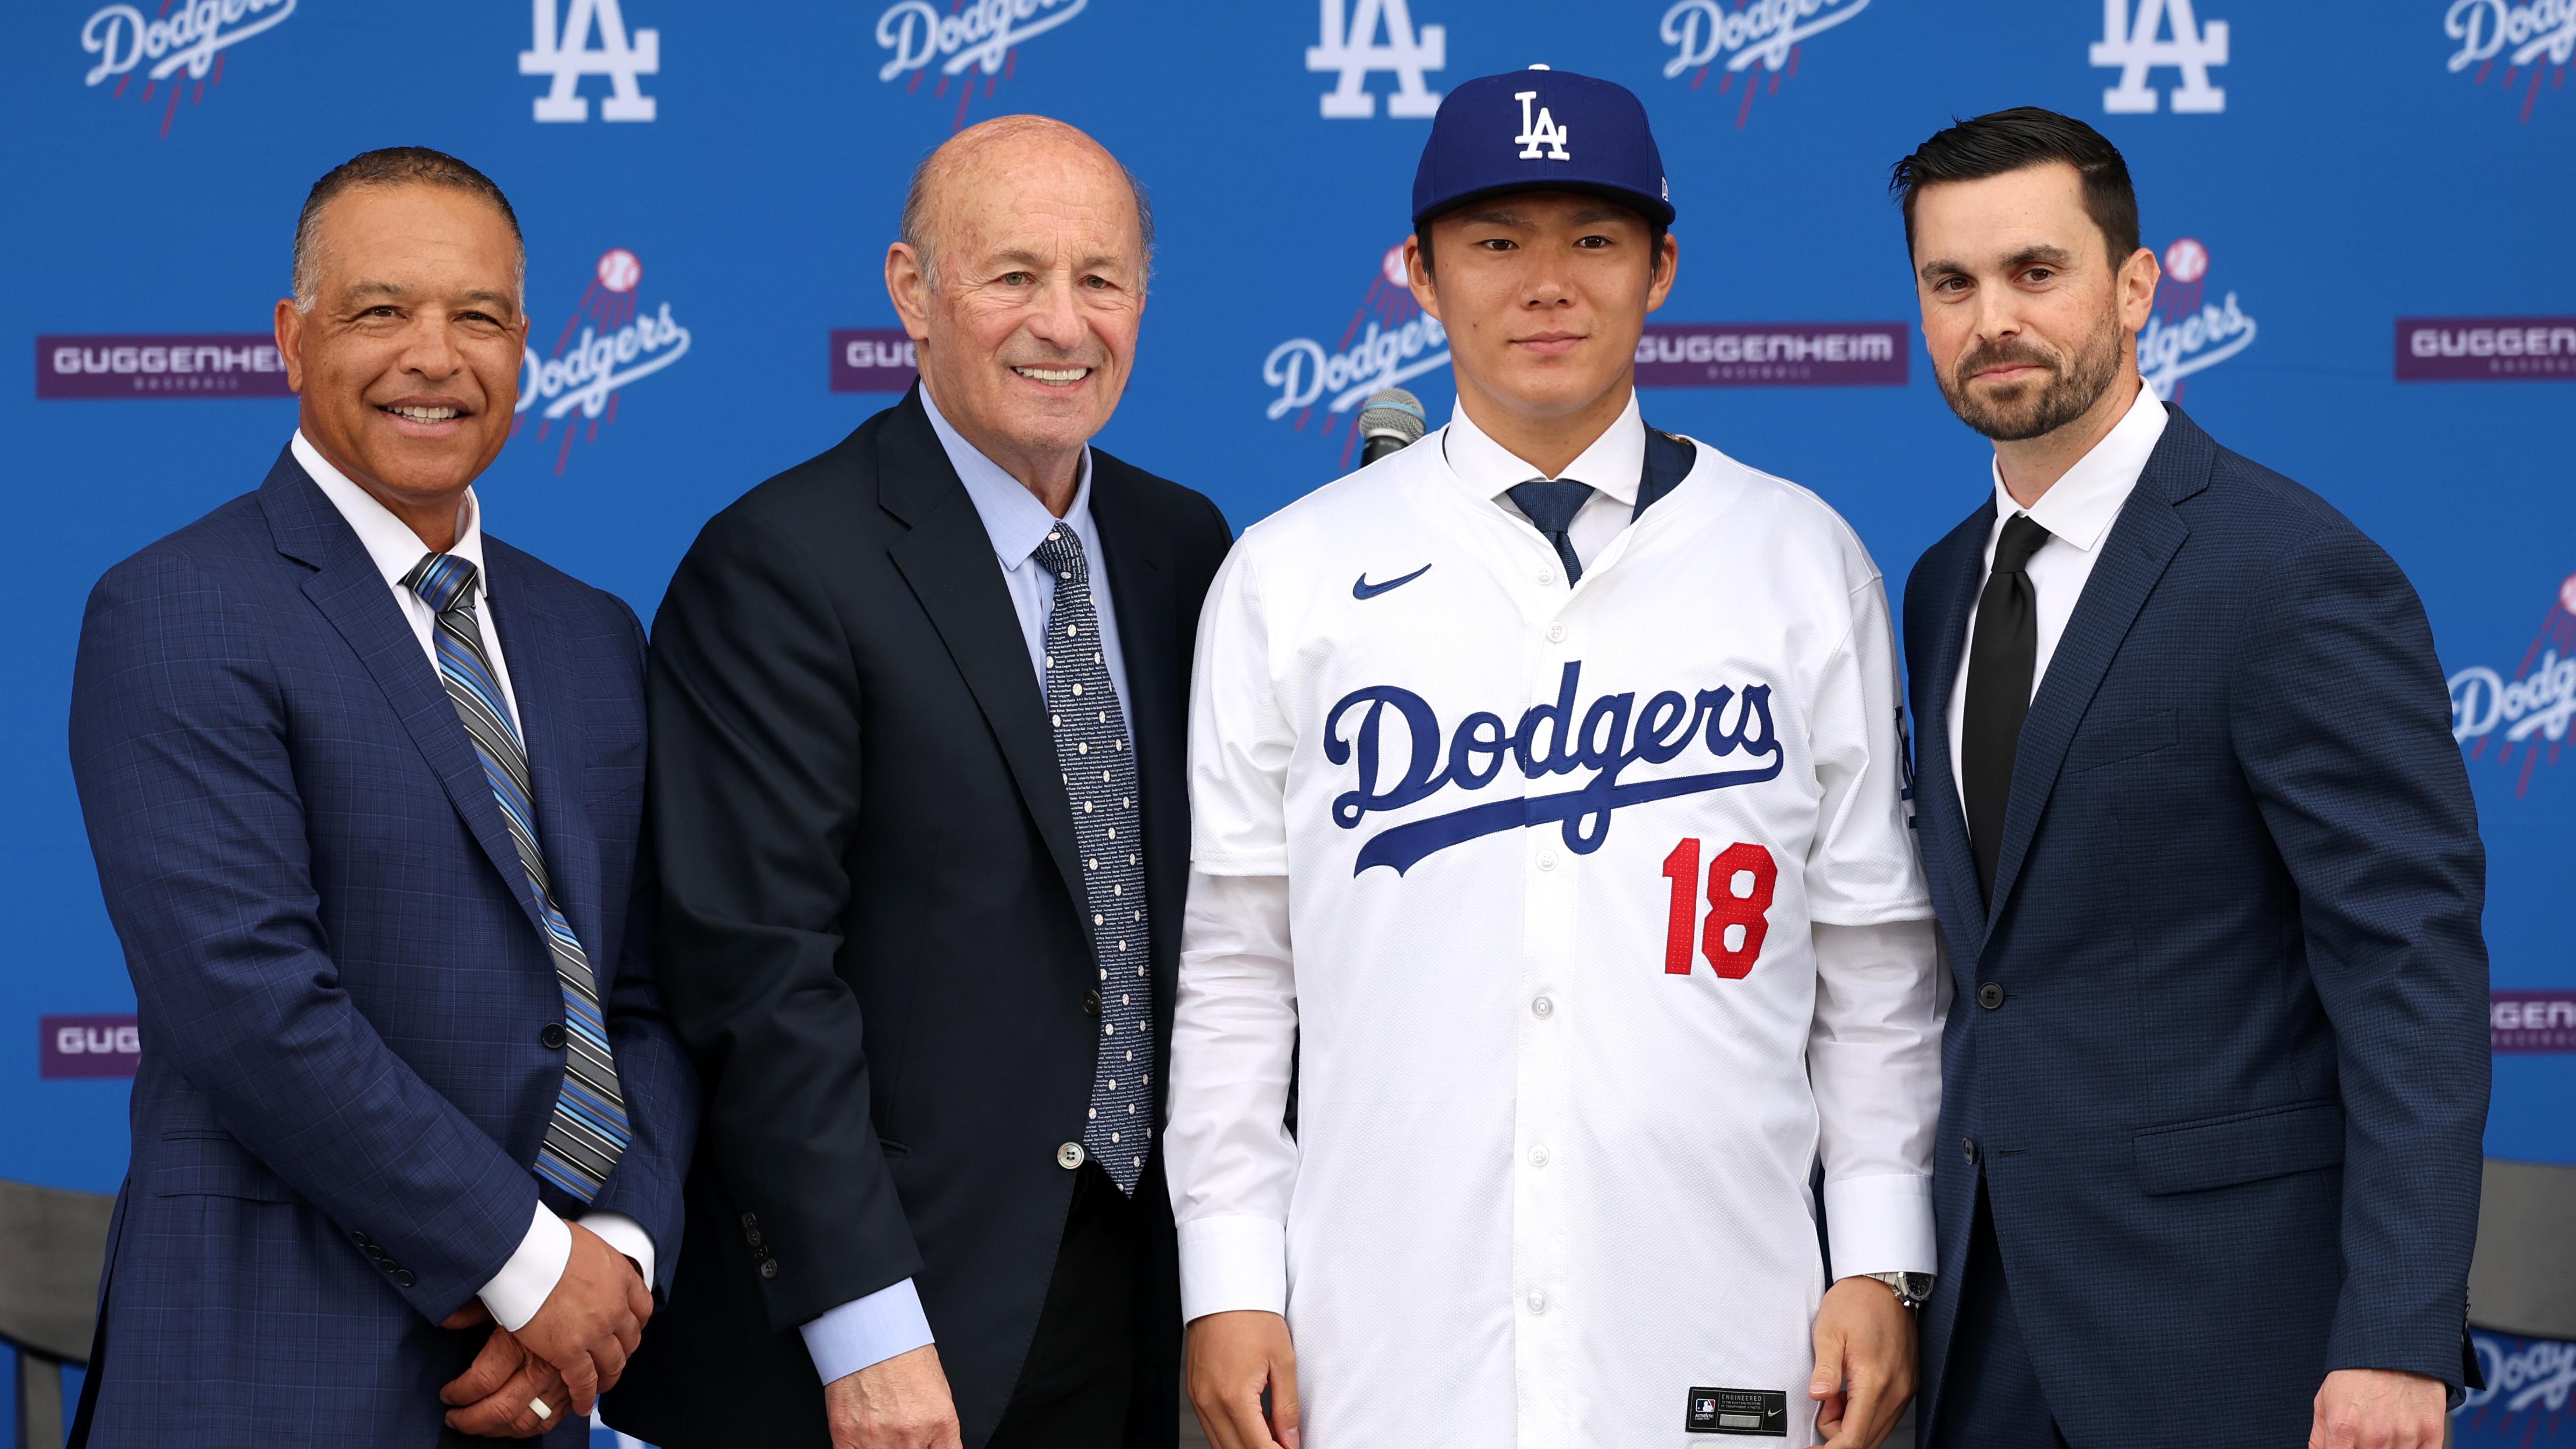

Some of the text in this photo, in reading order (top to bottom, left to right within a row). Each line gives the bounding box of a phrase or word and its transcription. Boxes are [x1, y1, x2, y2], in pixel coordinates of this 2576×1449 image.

[81, 0, 298, 87] Dodge
[1515, 91, 1570, 161] LA
[1263, 309, 1452, 420] Dodger
[1635, 334, 1893, 363] GUGGENHEIM
[2136, 290, 2256, 401] dgers
[1323, 660, 1784, 879] Dodgers
[1662, 837, 1778, 980] 18
